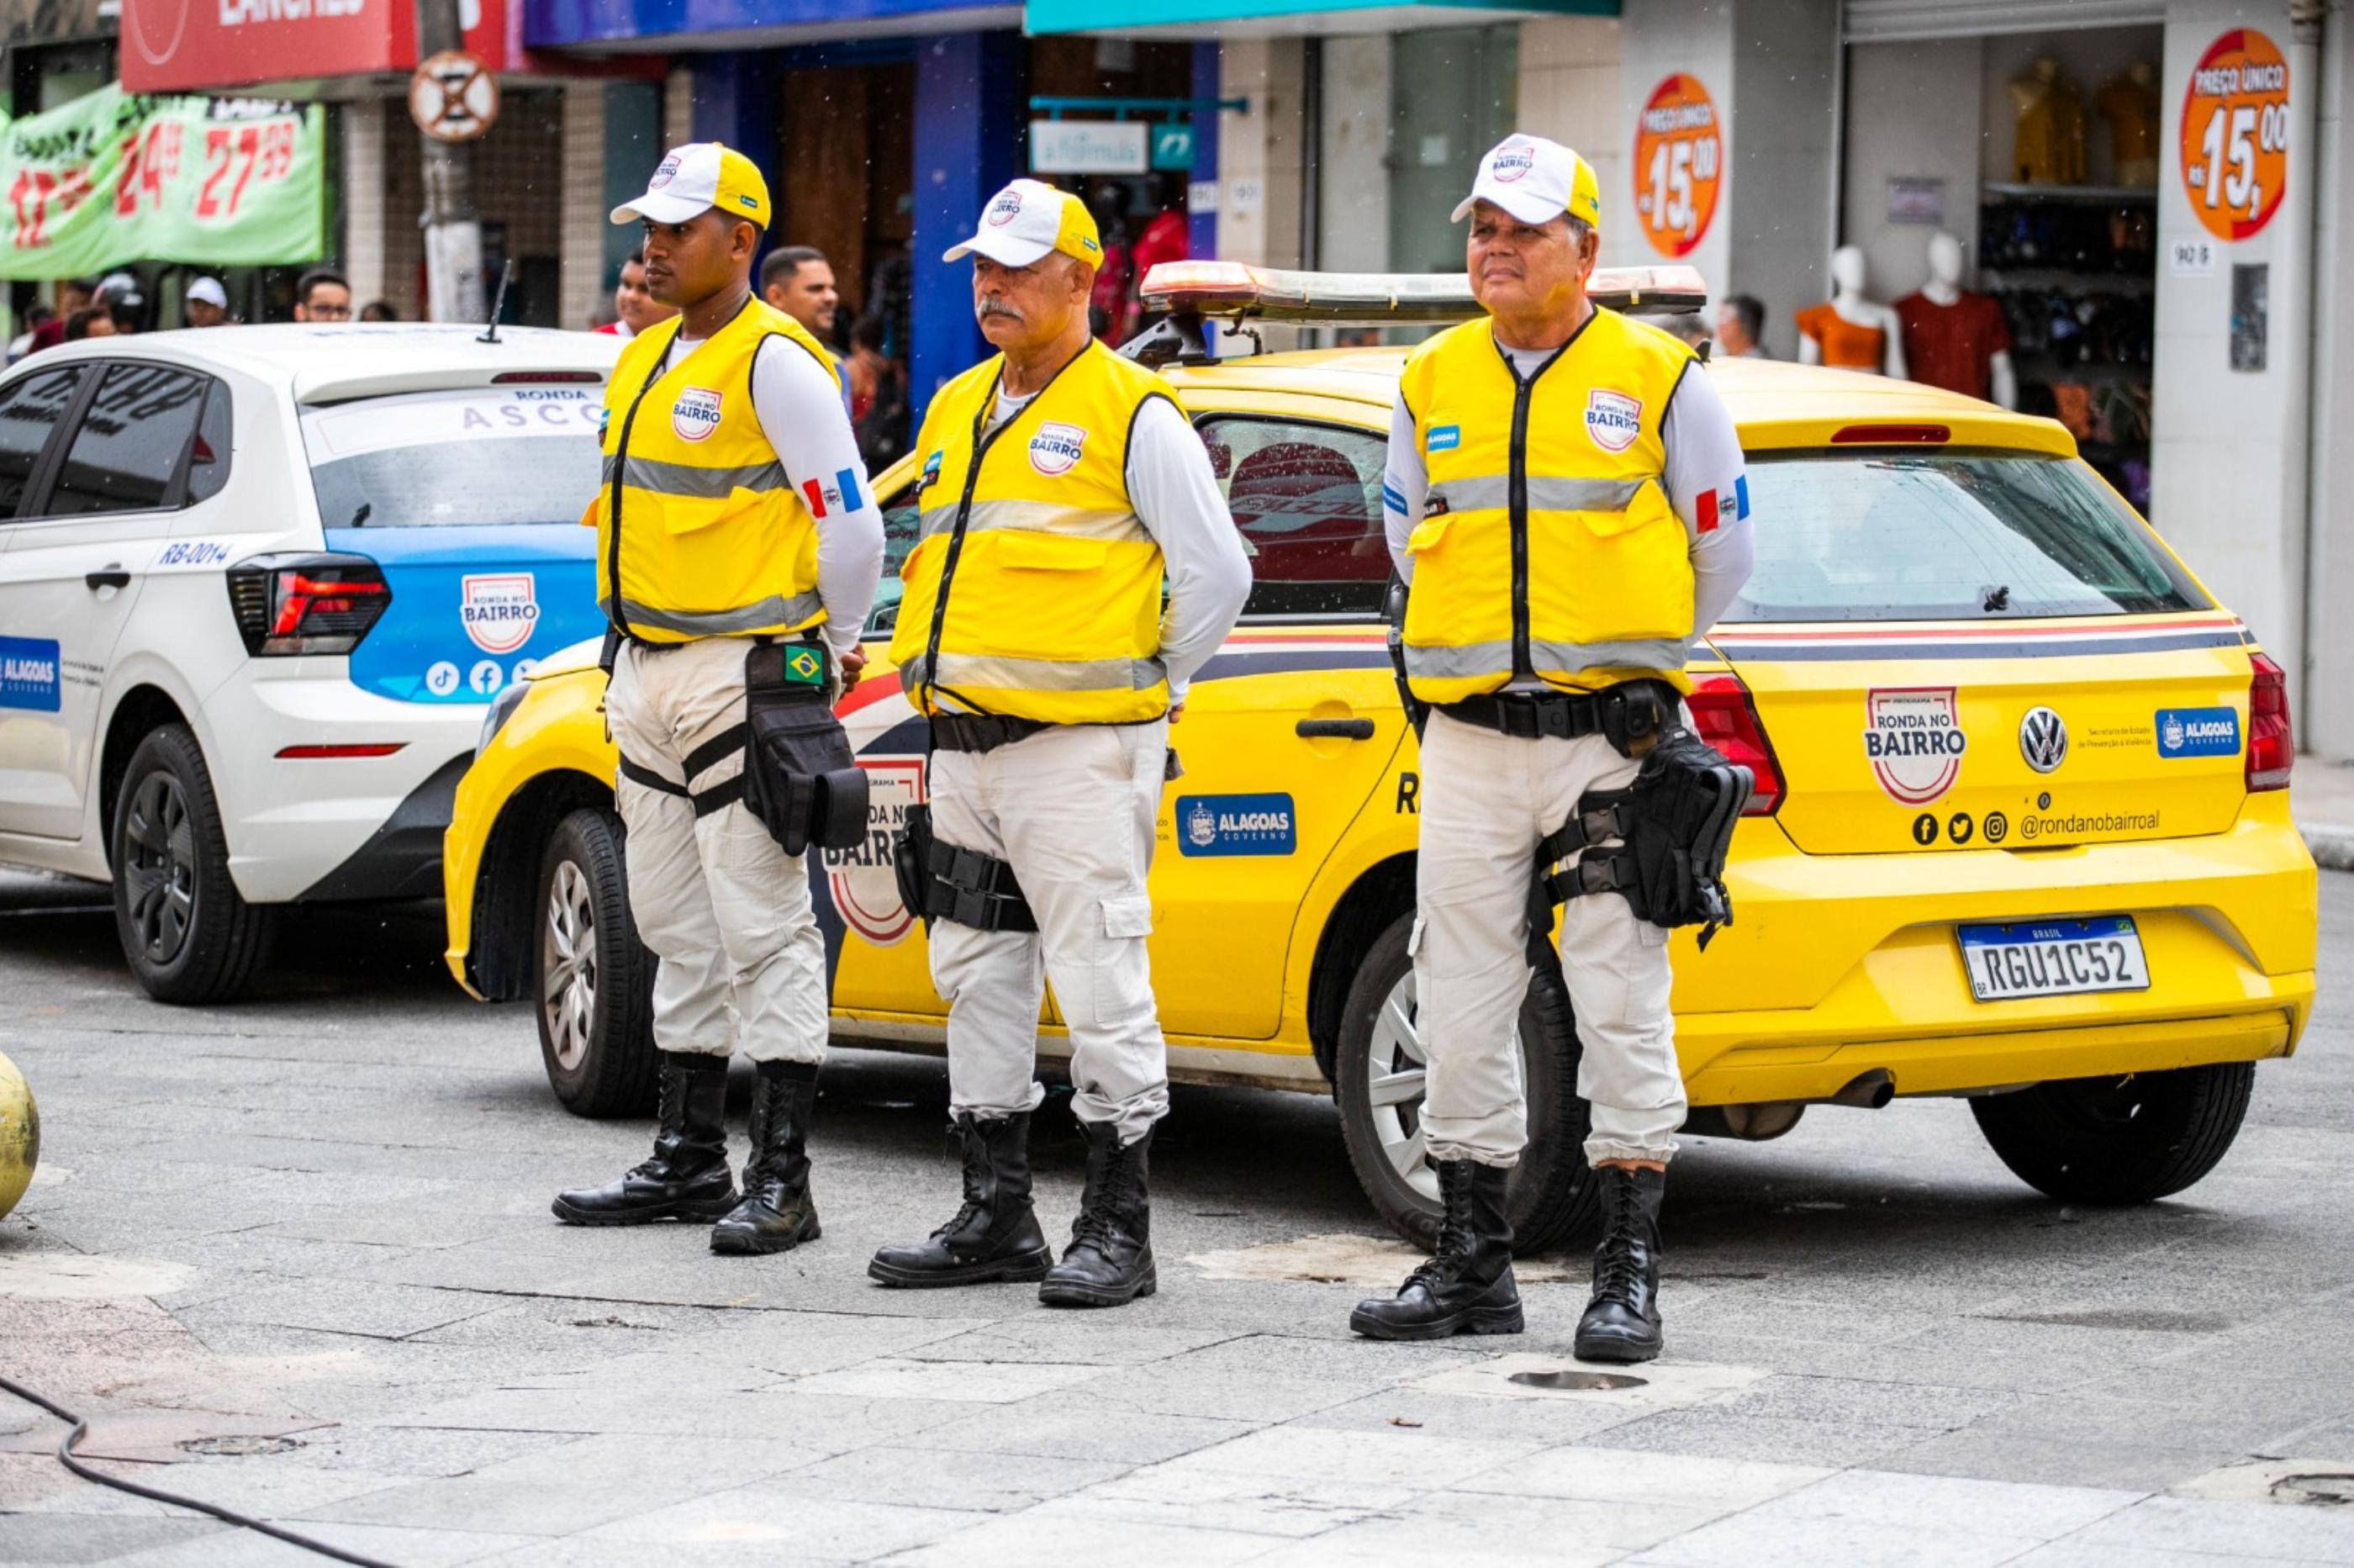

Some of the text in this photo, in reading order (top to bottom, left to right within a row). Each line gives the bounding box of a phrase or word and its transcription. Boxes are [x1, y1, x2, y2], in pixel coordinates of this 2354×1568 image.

[515, 390, 588, 401] RONDA
[673, 404, 720, 424] BAIRRO
[1586, 411, 1640, 433] BAIRRO
[1030, 438, 1082, 460] BAIRRO
[464, 604, 537, 622] BAIRRO
[4, 658, 54, 684] ALAGOAS
[1877, 714, 1950, 728] RONDA NO
[2187, 721, 2234, 737] ALAGOAS
[1865, 730, 1966, 757] BAIRRO
[1219, 812, 1289, 832] ALAGOAS
[2020, 810, 2160, 839] @rondanobairroal
[1223, 830, 1286, 842] GOVERNO
[2032, 927, 2062, 940] BRASIL
[1983, 941, 2132, 990] RGU1C52
